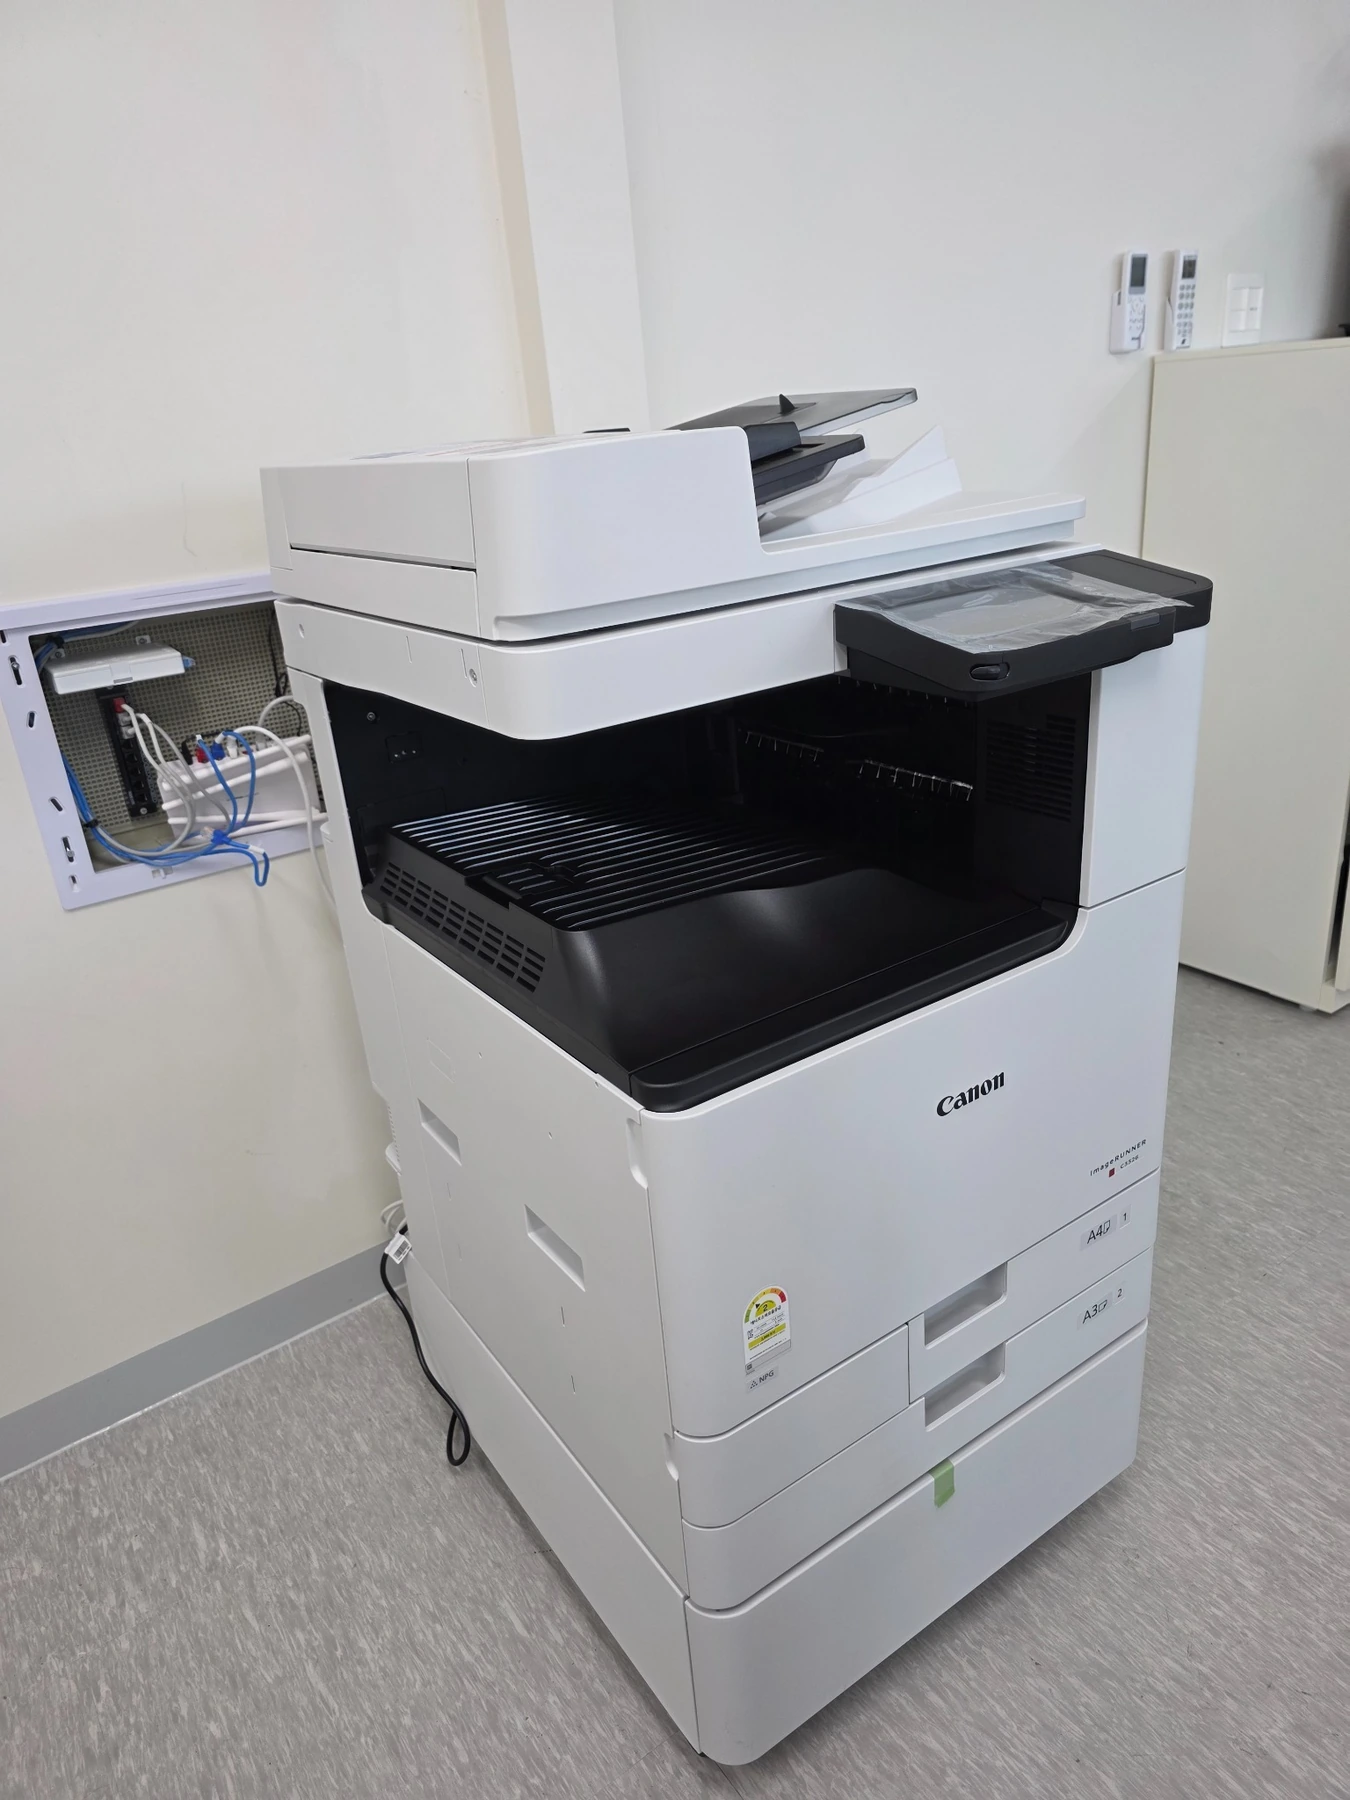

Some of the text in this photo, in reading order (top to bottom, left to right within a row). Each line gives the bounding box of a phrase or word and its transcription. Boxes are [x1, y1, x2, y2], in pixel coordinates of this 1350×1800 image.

[936, 1071, 1005, 1117] Canon
[1090, 1139, 1147, 1177] imageRUNNER
[1123, 1212, 1128, 1222] 1
[762, 1303, 769, 1313] 2
[1082, 1288, 1123, 1325] A3 2
[758, 1369, 775, 1384] NPG
